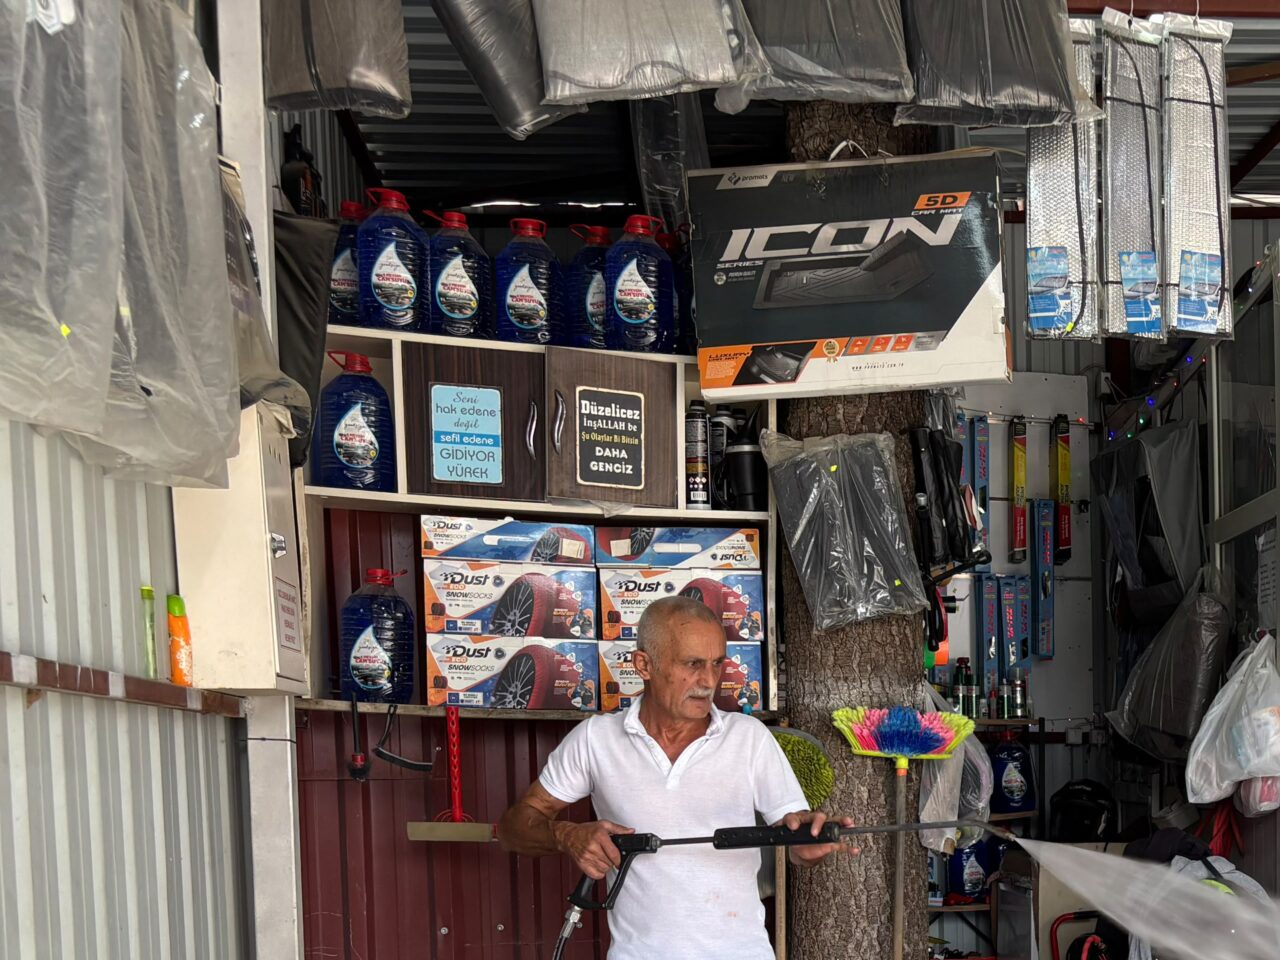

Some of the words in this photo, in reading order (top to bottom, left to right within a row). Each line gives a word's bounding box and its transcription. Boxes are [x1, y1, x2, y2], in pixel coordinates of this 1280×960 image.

[924, 194, 959, 207] 5D
[720, 214, 963, 261] ICON
[716, 260, 764, 270] SERIES
[452, 391, 479, 404] Seni
[436, 403, 457, 415] hak
[460, 406, 497, 417] edene
[580, 400, 640, 420] Düzelicez
[454, 418, 480, 431] değil
[627, 423, 638, 432] be
[440, 433, 460, 443] sefil
[462, 434, 494, 445] edene
[439, 446, 496, 462] GİDİYOR
[595, 446, 628, 459] DAHA
[447, 463, 488, 479] YÜREK
[589, 461, 633, 475] GENCİZ
[437, 520, 463, 530] Dust
[451, 572, 490, 586] Dust
[625, 580, 661, 593] Dust
[445, 591, 493, 599] SNOWSOCKS
[453, 645, 491, 658] Dust
[447, 663, 495, 672] SNOWSOCKS
